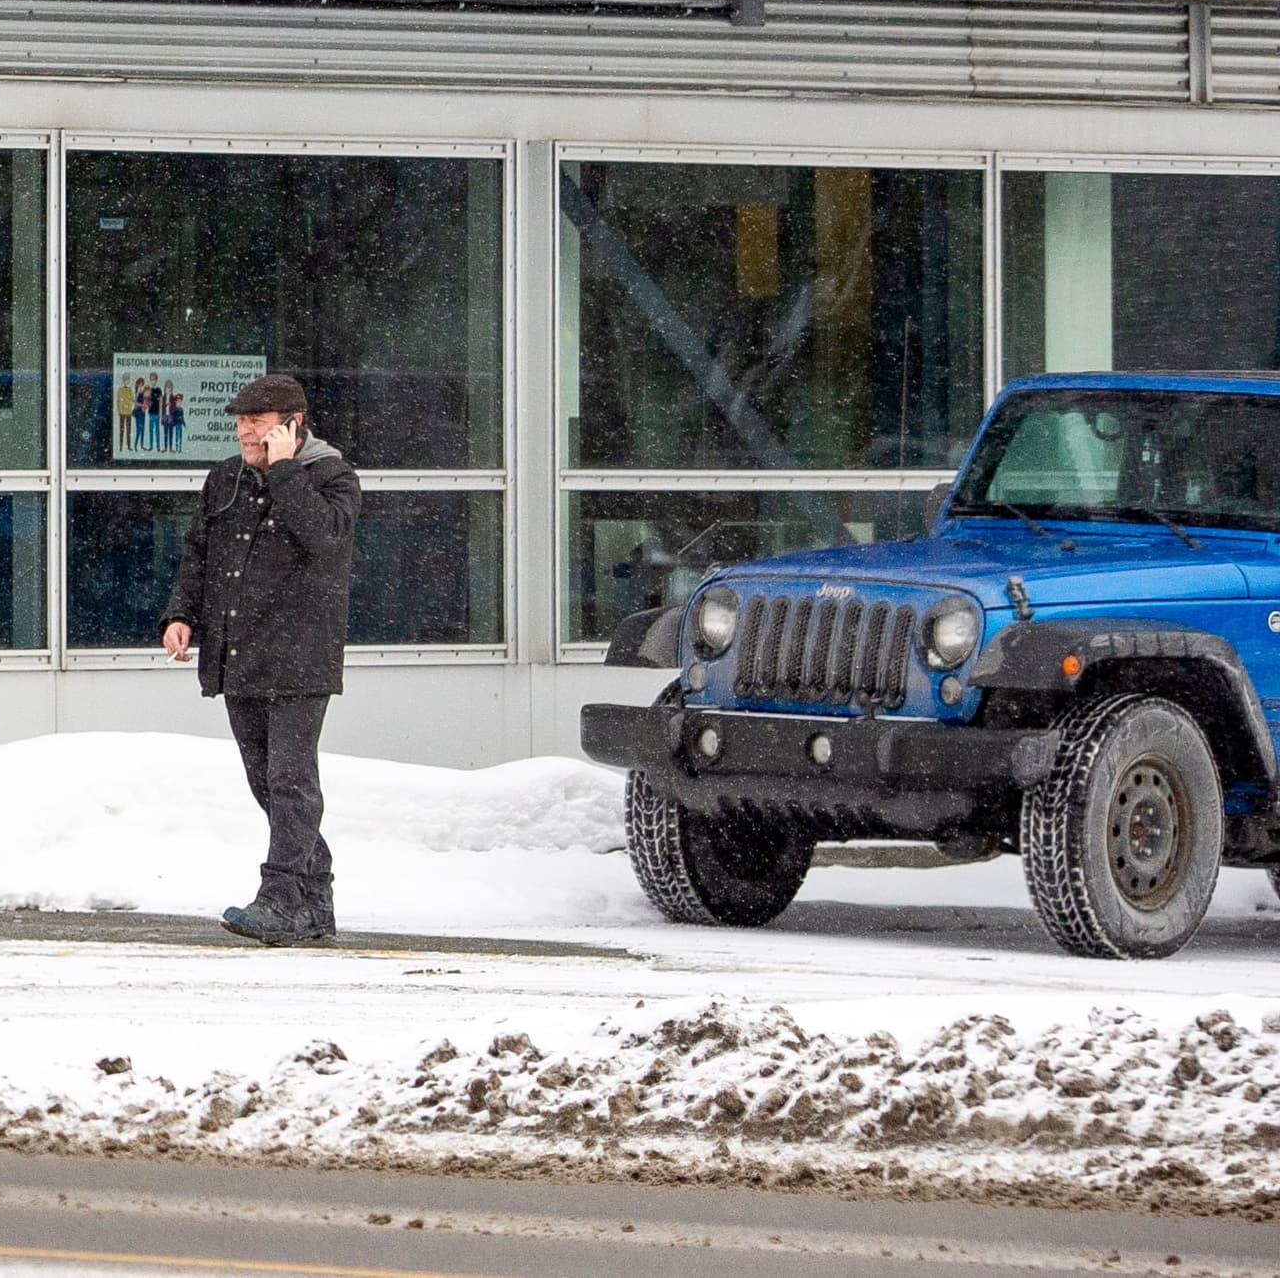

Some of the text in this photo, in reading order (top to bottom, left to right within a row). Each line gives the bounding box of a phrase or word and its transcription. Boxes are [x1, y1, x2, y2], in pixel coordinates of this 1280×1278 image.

[116, 357, 150, 367] RESTONS
[190, 359, 219, 369] CONTRE
[220, 359, 230, 369] LA
[233, 371, 251, 379] Pour
[189, 407, 211, 417] PORT
[213, 408, 225, 418] DU
[207, 421, 238, 432] OBLIGA
[816, 582, 852, 600] Jeep
